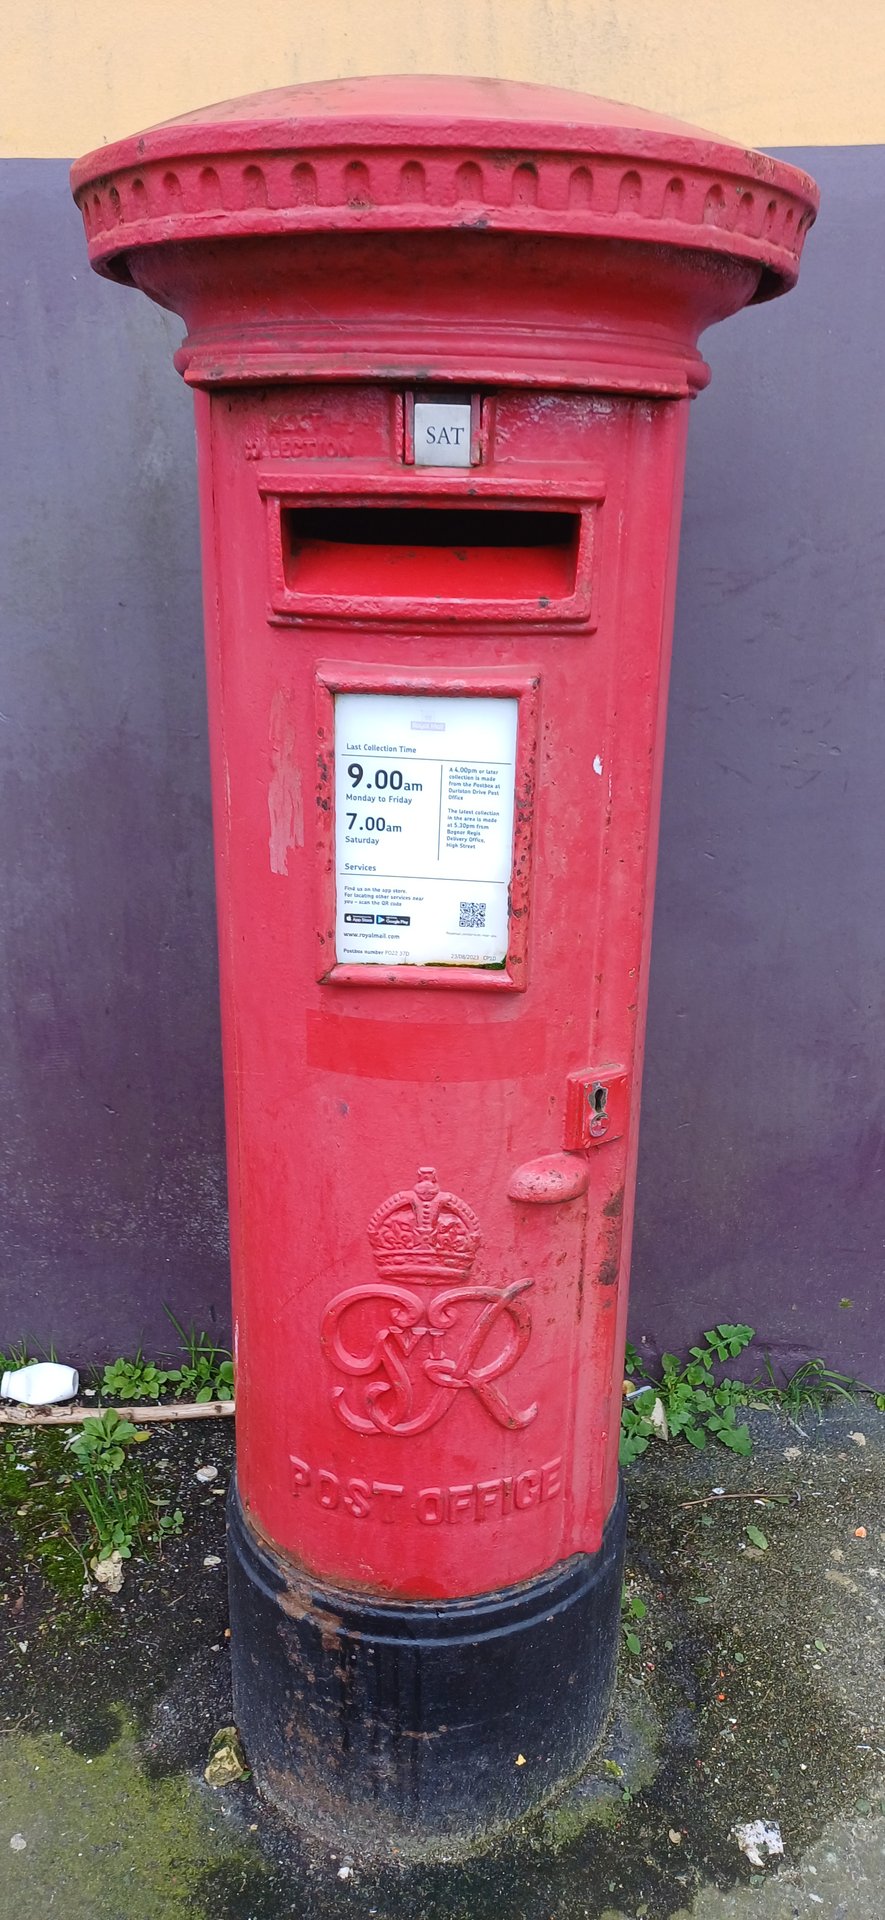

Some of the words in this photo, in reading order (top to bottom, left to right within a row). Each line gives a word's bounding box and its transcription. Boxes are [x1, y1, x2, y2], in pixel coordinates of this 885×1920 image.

[426, 426, 465, 446] SAT
[347, 763, 423, 791] 9.00am
[346, 794, 375, 803] Monday
[388, 796, 412, 805] Friday
[346, 812, 402, 832] 7.00am
[345, 836, 379, 845] Saturday
[344, 863, 376, 871] Services
[289, 1453, 404, 1524] POST
[416, 1456, 562, 1525] OFFICE
